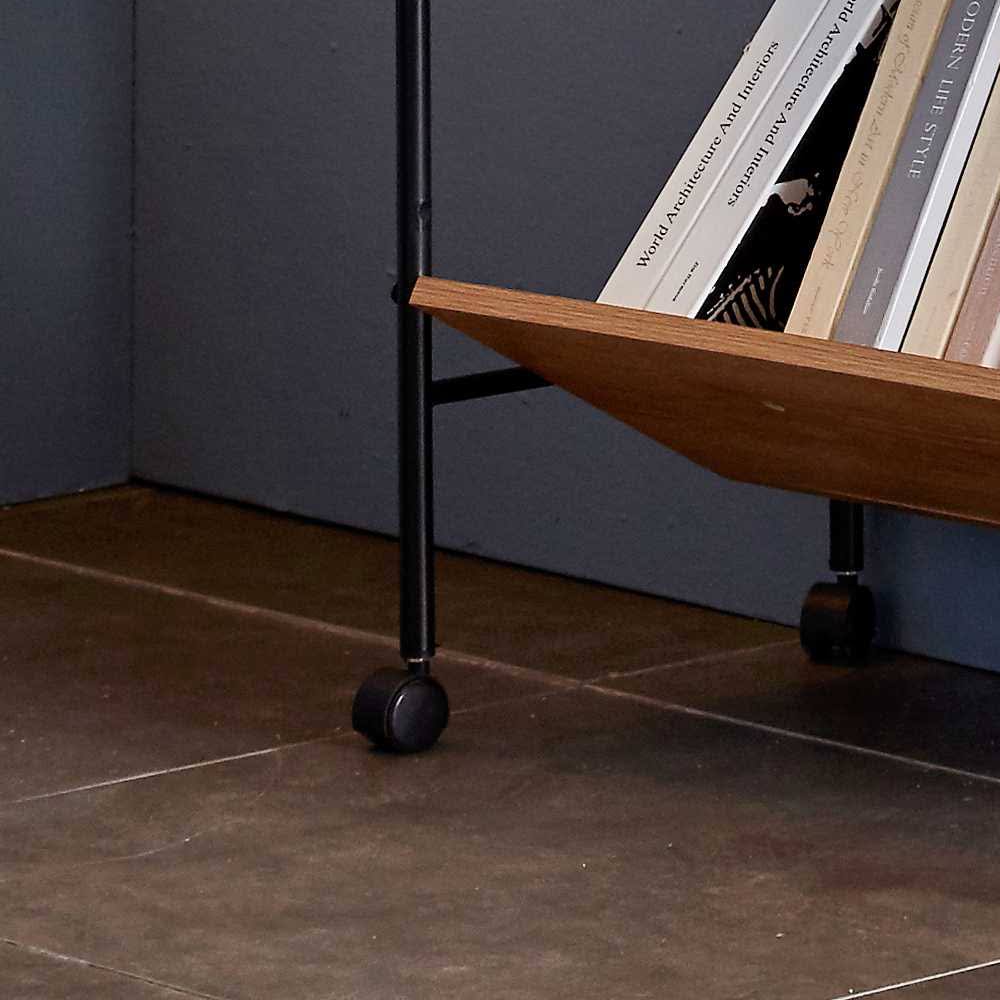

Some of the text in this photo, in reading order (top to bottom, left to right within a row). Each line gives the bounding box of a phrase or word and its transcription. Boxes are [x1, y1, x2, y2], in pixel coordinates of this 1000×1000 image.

[785, 23, 841, 111] Architecture
[928, 78, 954, 117] LIFE
[636, 40, 780, 269] World Architecture And Interiors
[765, 110, 789, 144] And
[907, 121, 938, 179] STYLE
[727, 143, 769, 207] Interiors
